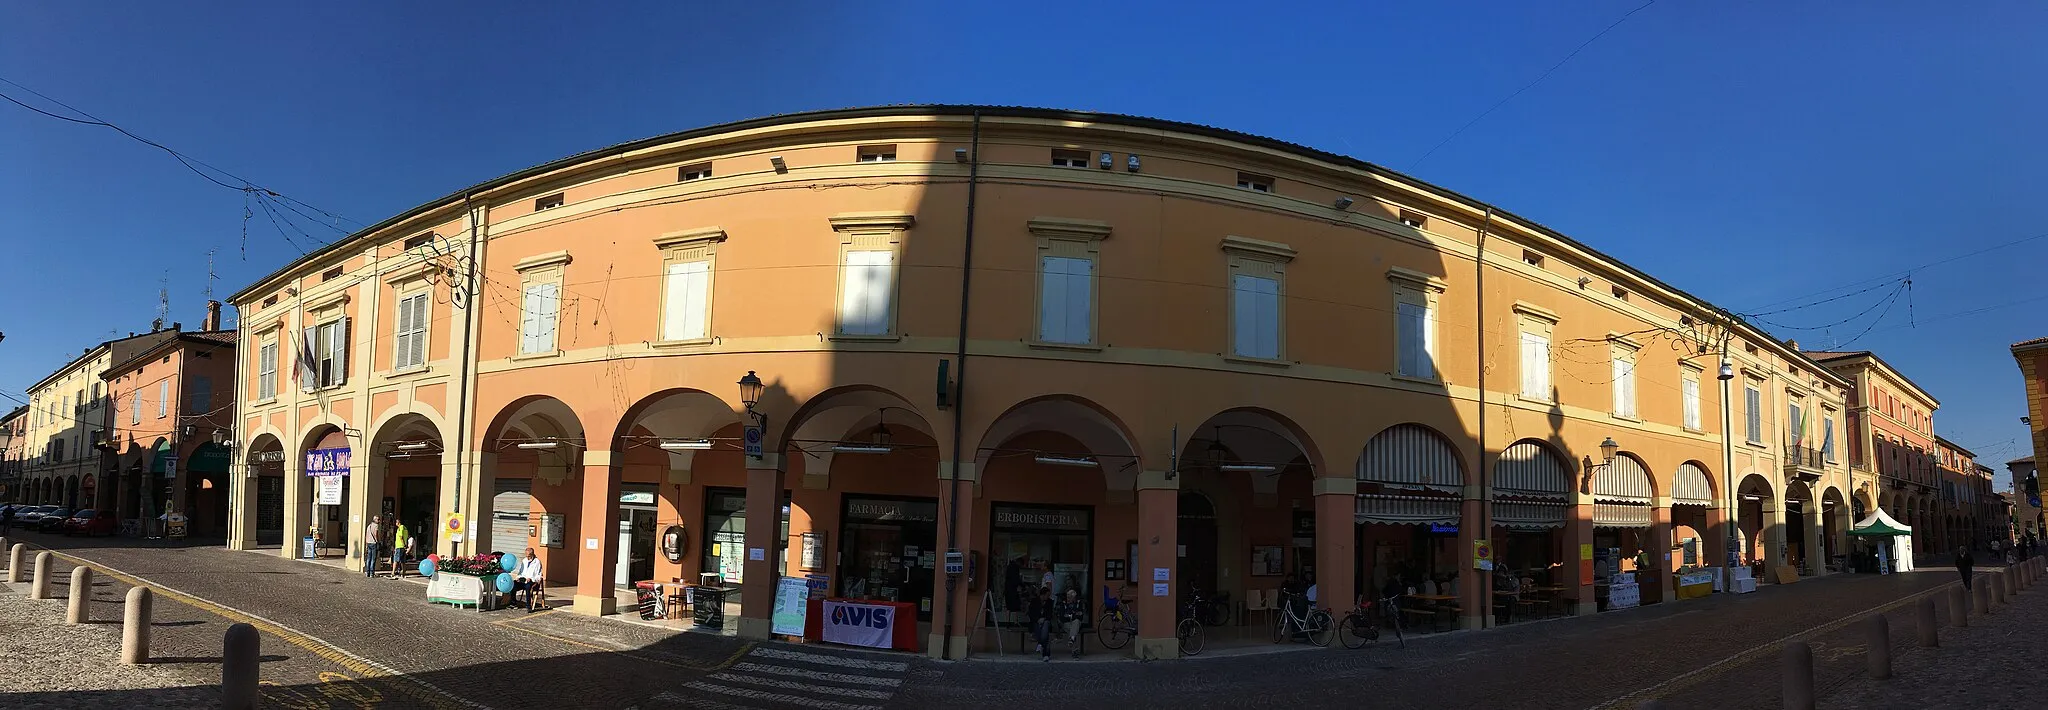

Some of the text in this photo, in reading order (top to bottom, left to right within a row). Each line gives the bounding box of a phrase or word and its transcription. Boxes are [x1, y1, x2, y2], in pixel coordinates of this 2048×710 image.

[849, 504, 902, 516] FARMACIA
[997, 512, 1079, 525] ERBORISTERIA
[806, 579, 827, 589] AVIS
[831, 605, 888, 630] AVIS
